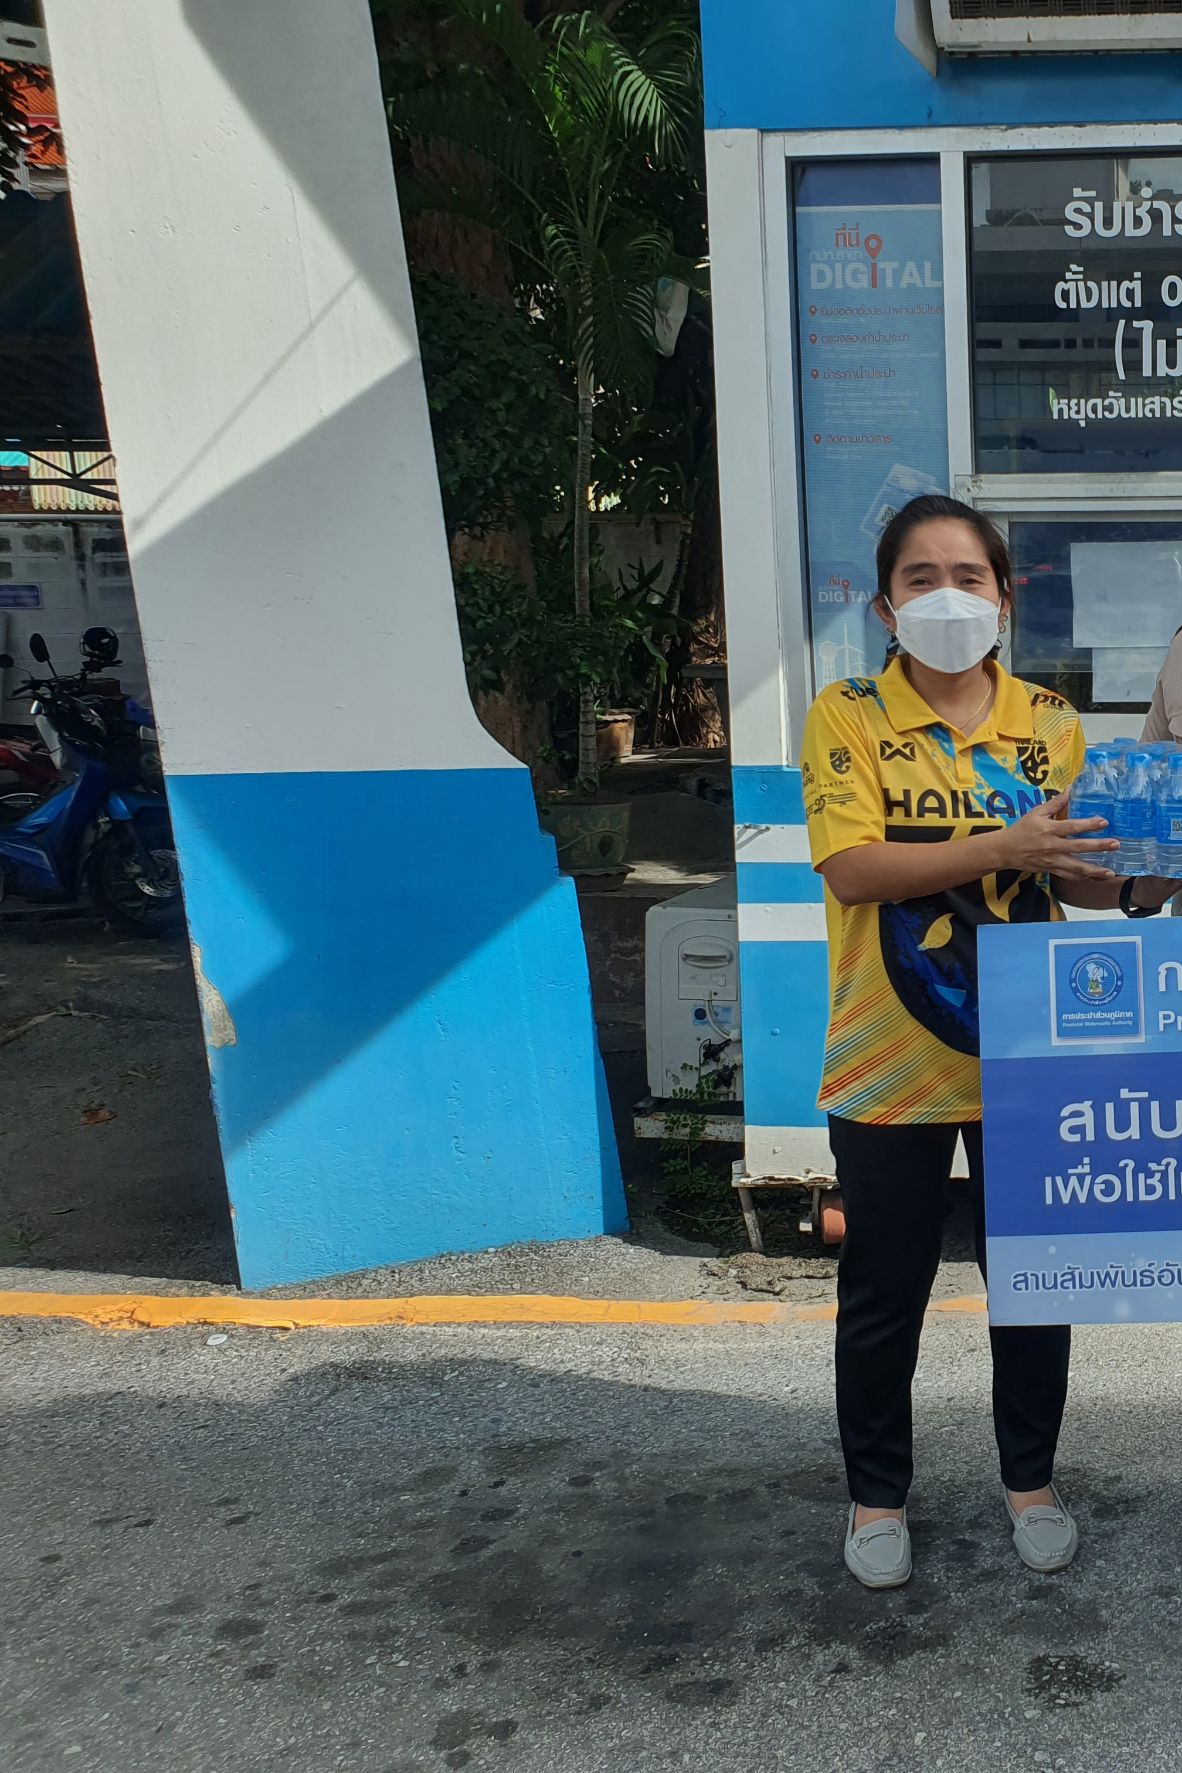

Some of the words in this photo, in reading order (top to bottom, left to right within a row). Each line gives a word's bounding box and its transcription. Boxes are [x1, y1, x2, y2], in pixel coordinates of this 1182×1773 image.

[834, 223, 860, 248] ที่นี่
[810, 261, 943, 290] DIGITAL
[1054, 265, 1143, 309] ตั้งแต่
[883, 787, 1062, 819] HAILAN
